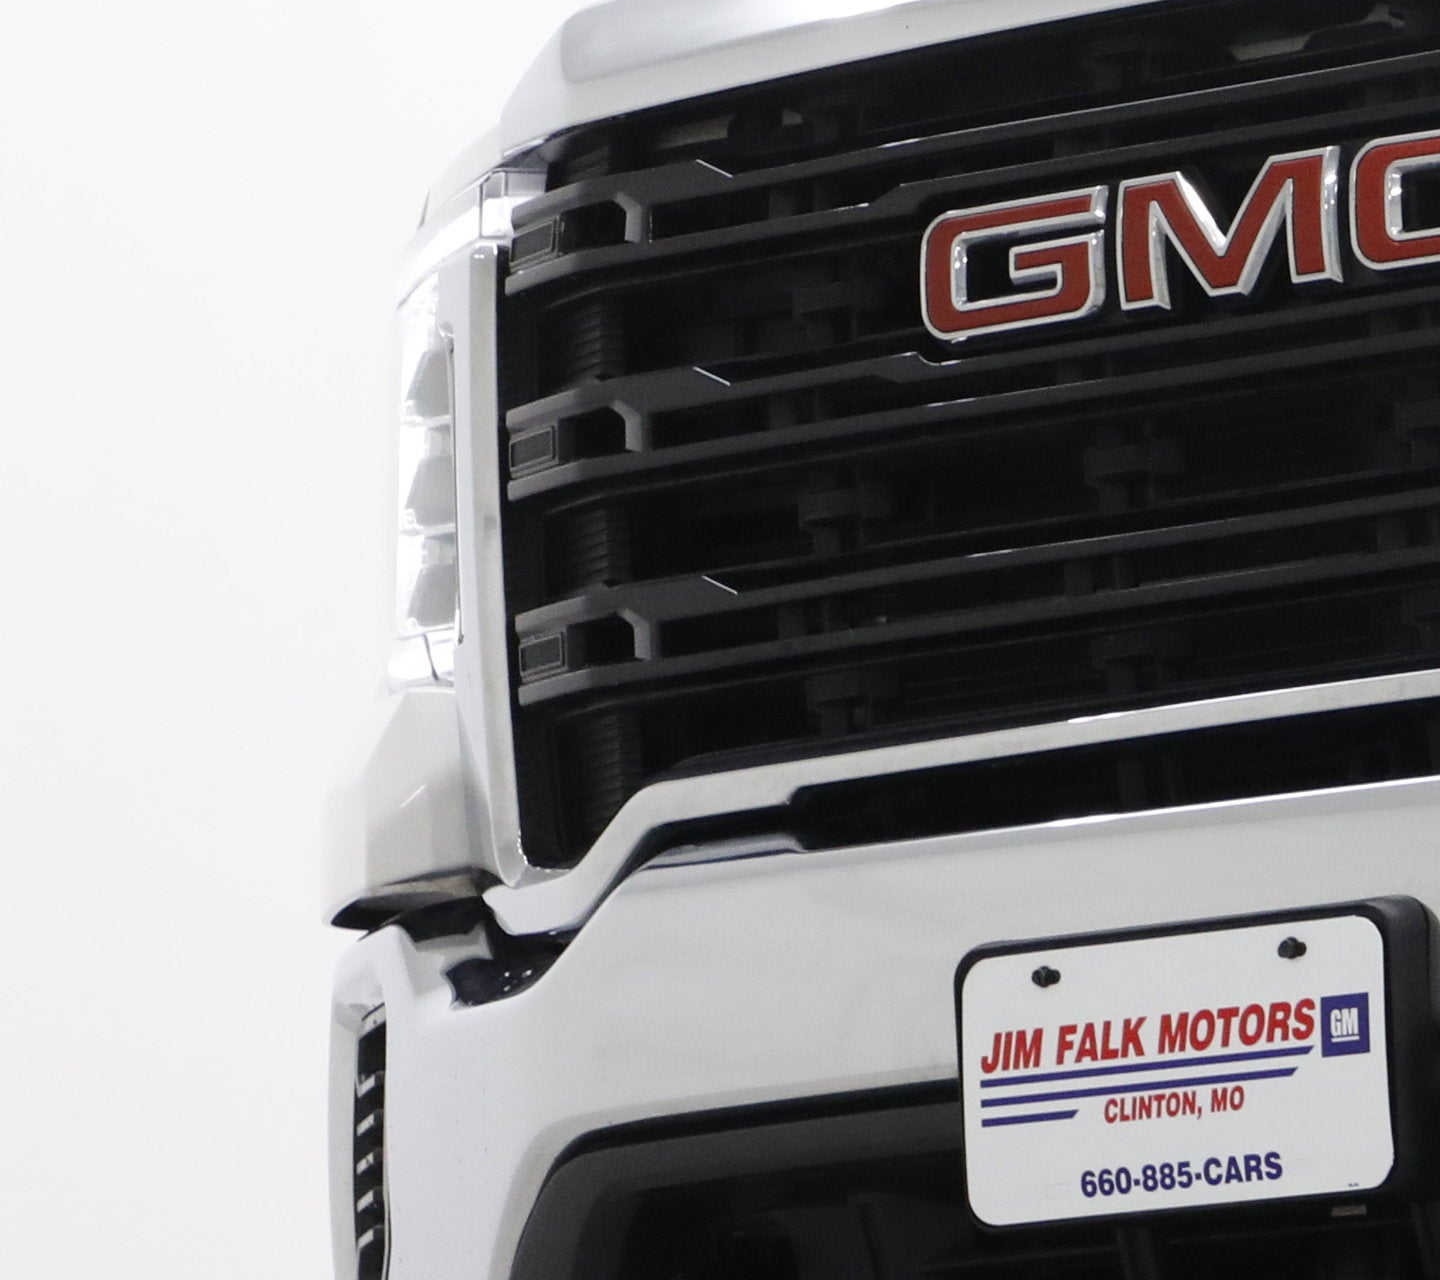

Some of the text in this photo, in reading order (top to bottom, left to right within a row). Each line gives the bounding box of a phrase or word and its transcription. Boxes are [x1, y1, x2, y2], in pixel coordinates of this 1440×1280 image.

[981, 998, 1315, 1073] JIM FALK MOTORS
[1330, 1007, 1359, 1043] GM
[1104, 1085, 1245, 1124] CLINTON, MO
[1080, 1152, 1283, 1197] 660-885-CARS
